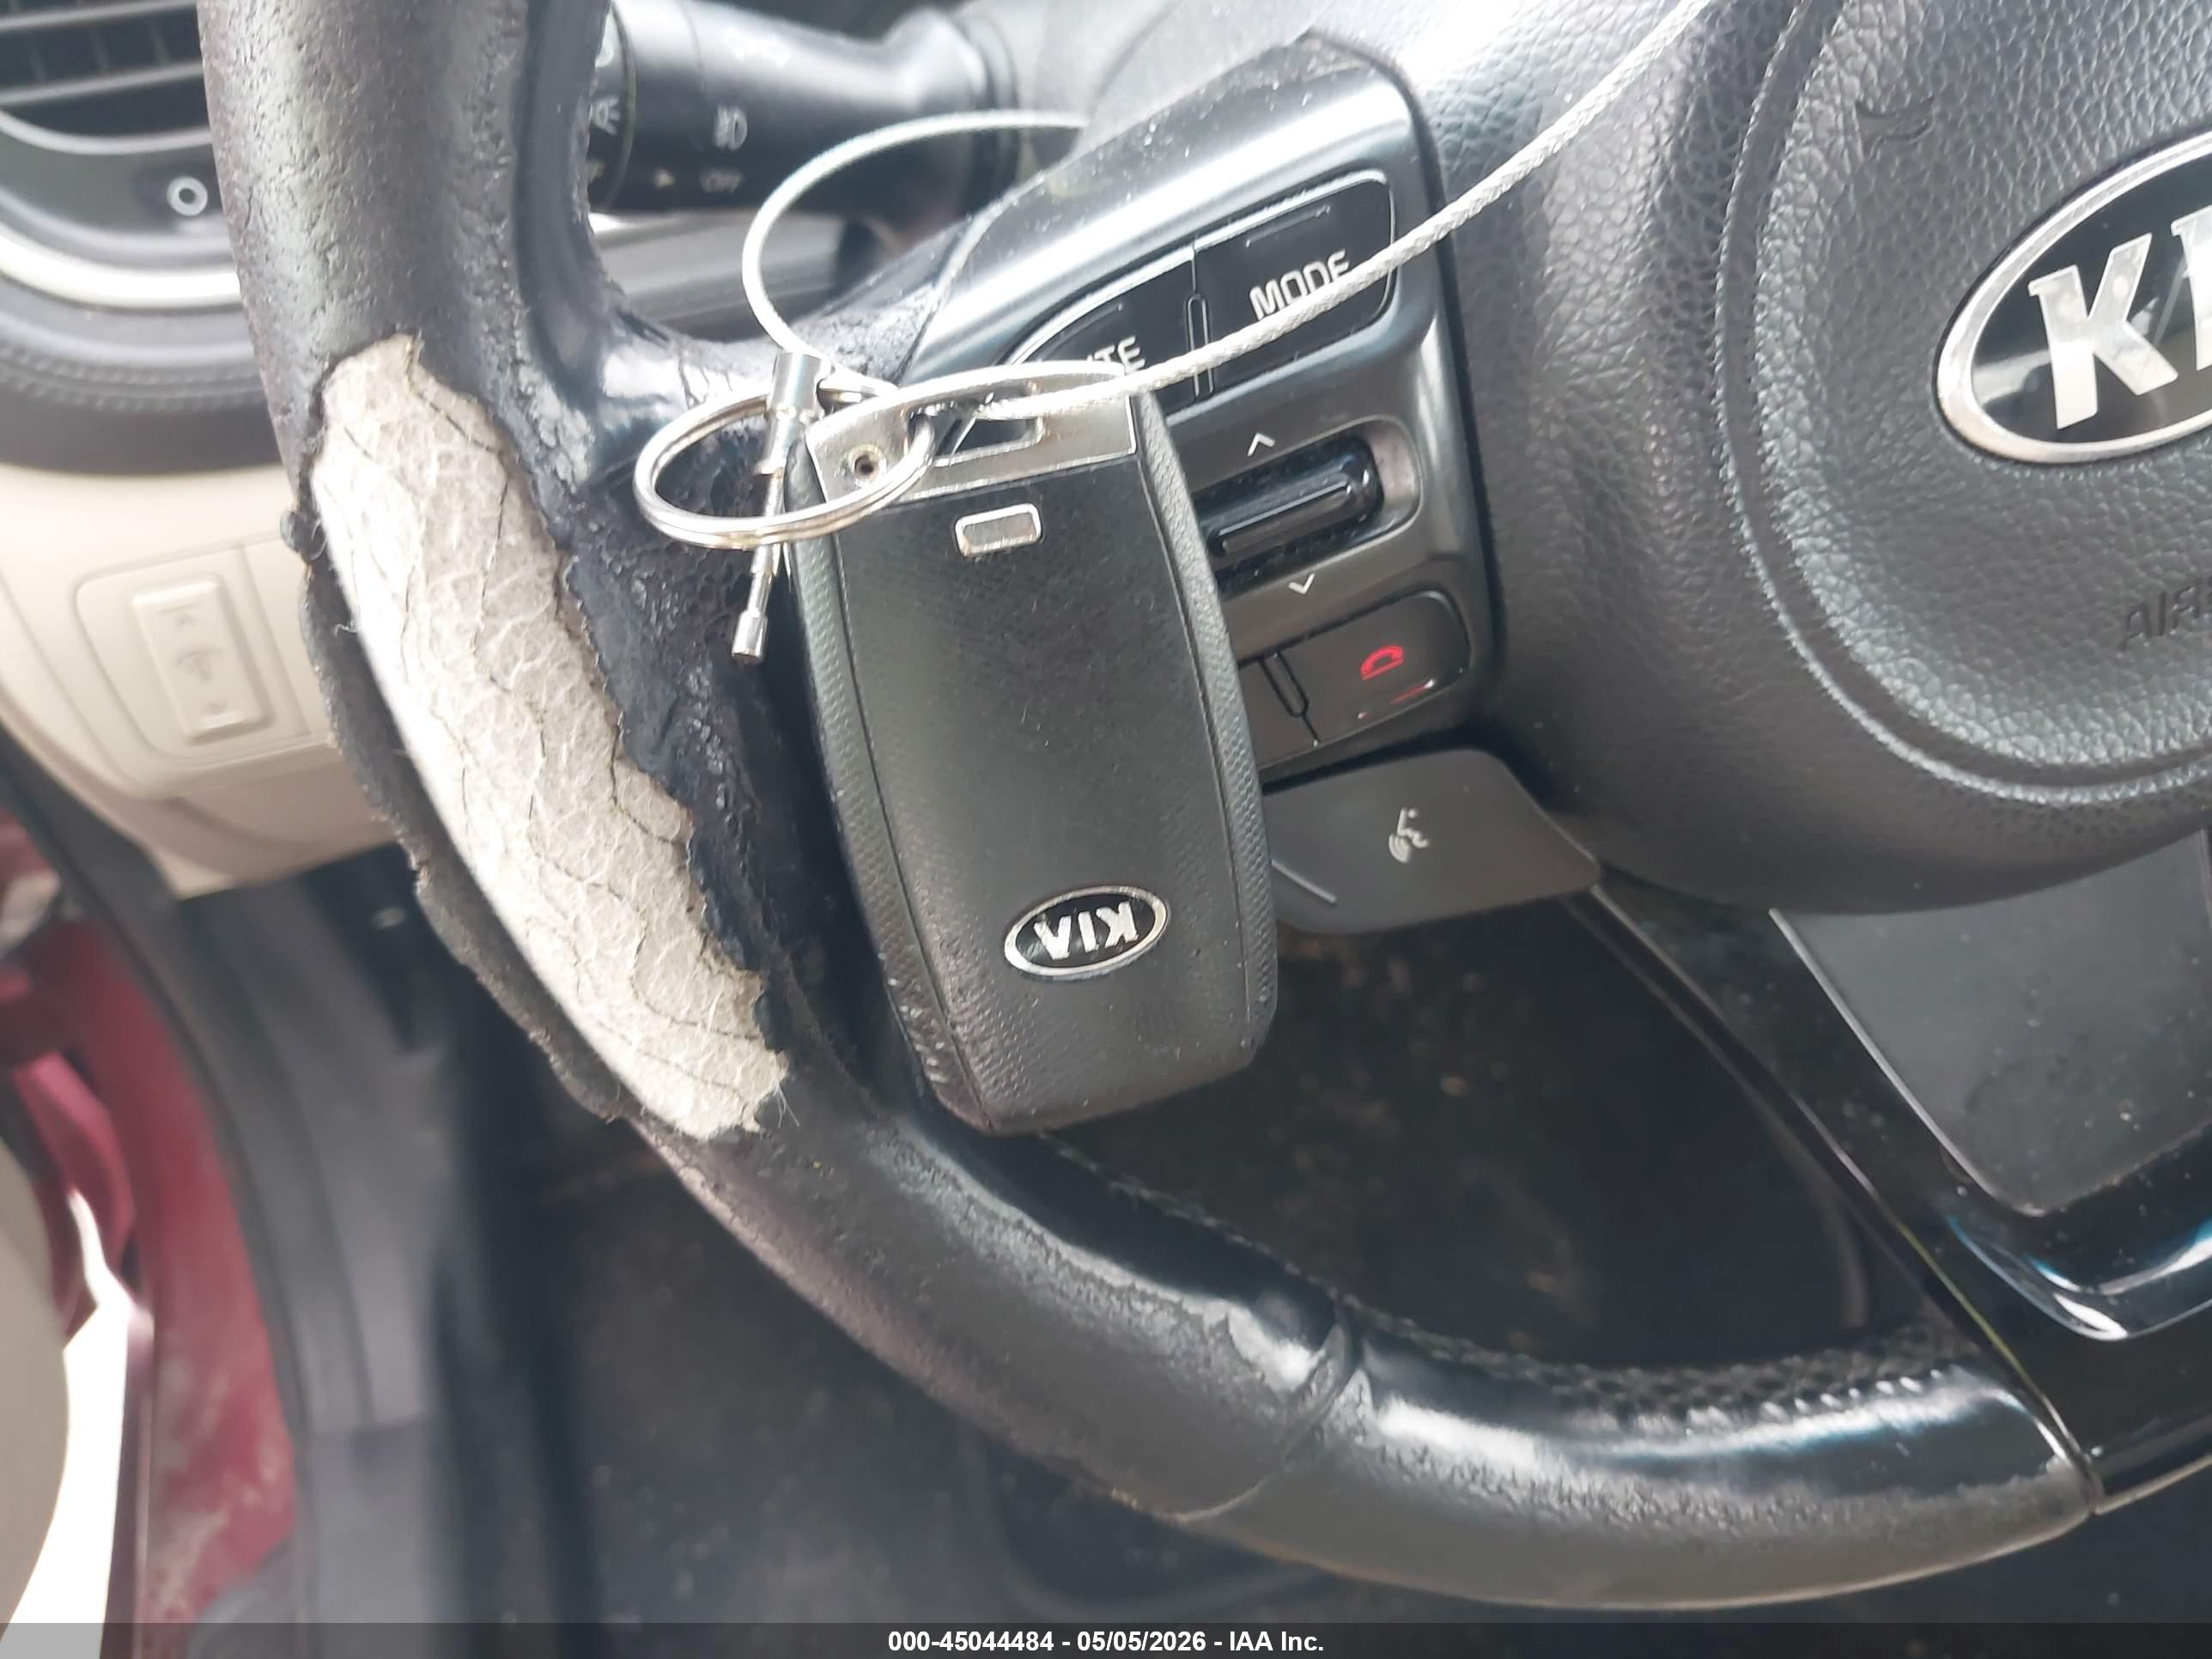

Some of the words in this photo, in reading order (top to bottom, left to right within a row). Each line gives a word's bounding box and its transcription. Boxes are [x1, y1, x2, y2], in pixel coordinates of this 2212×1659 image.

[1249, 248, 1349, 321] MODE
[2117, 574, 2212, 652] AIR
[1033, 902, 1139, 960] KIA
